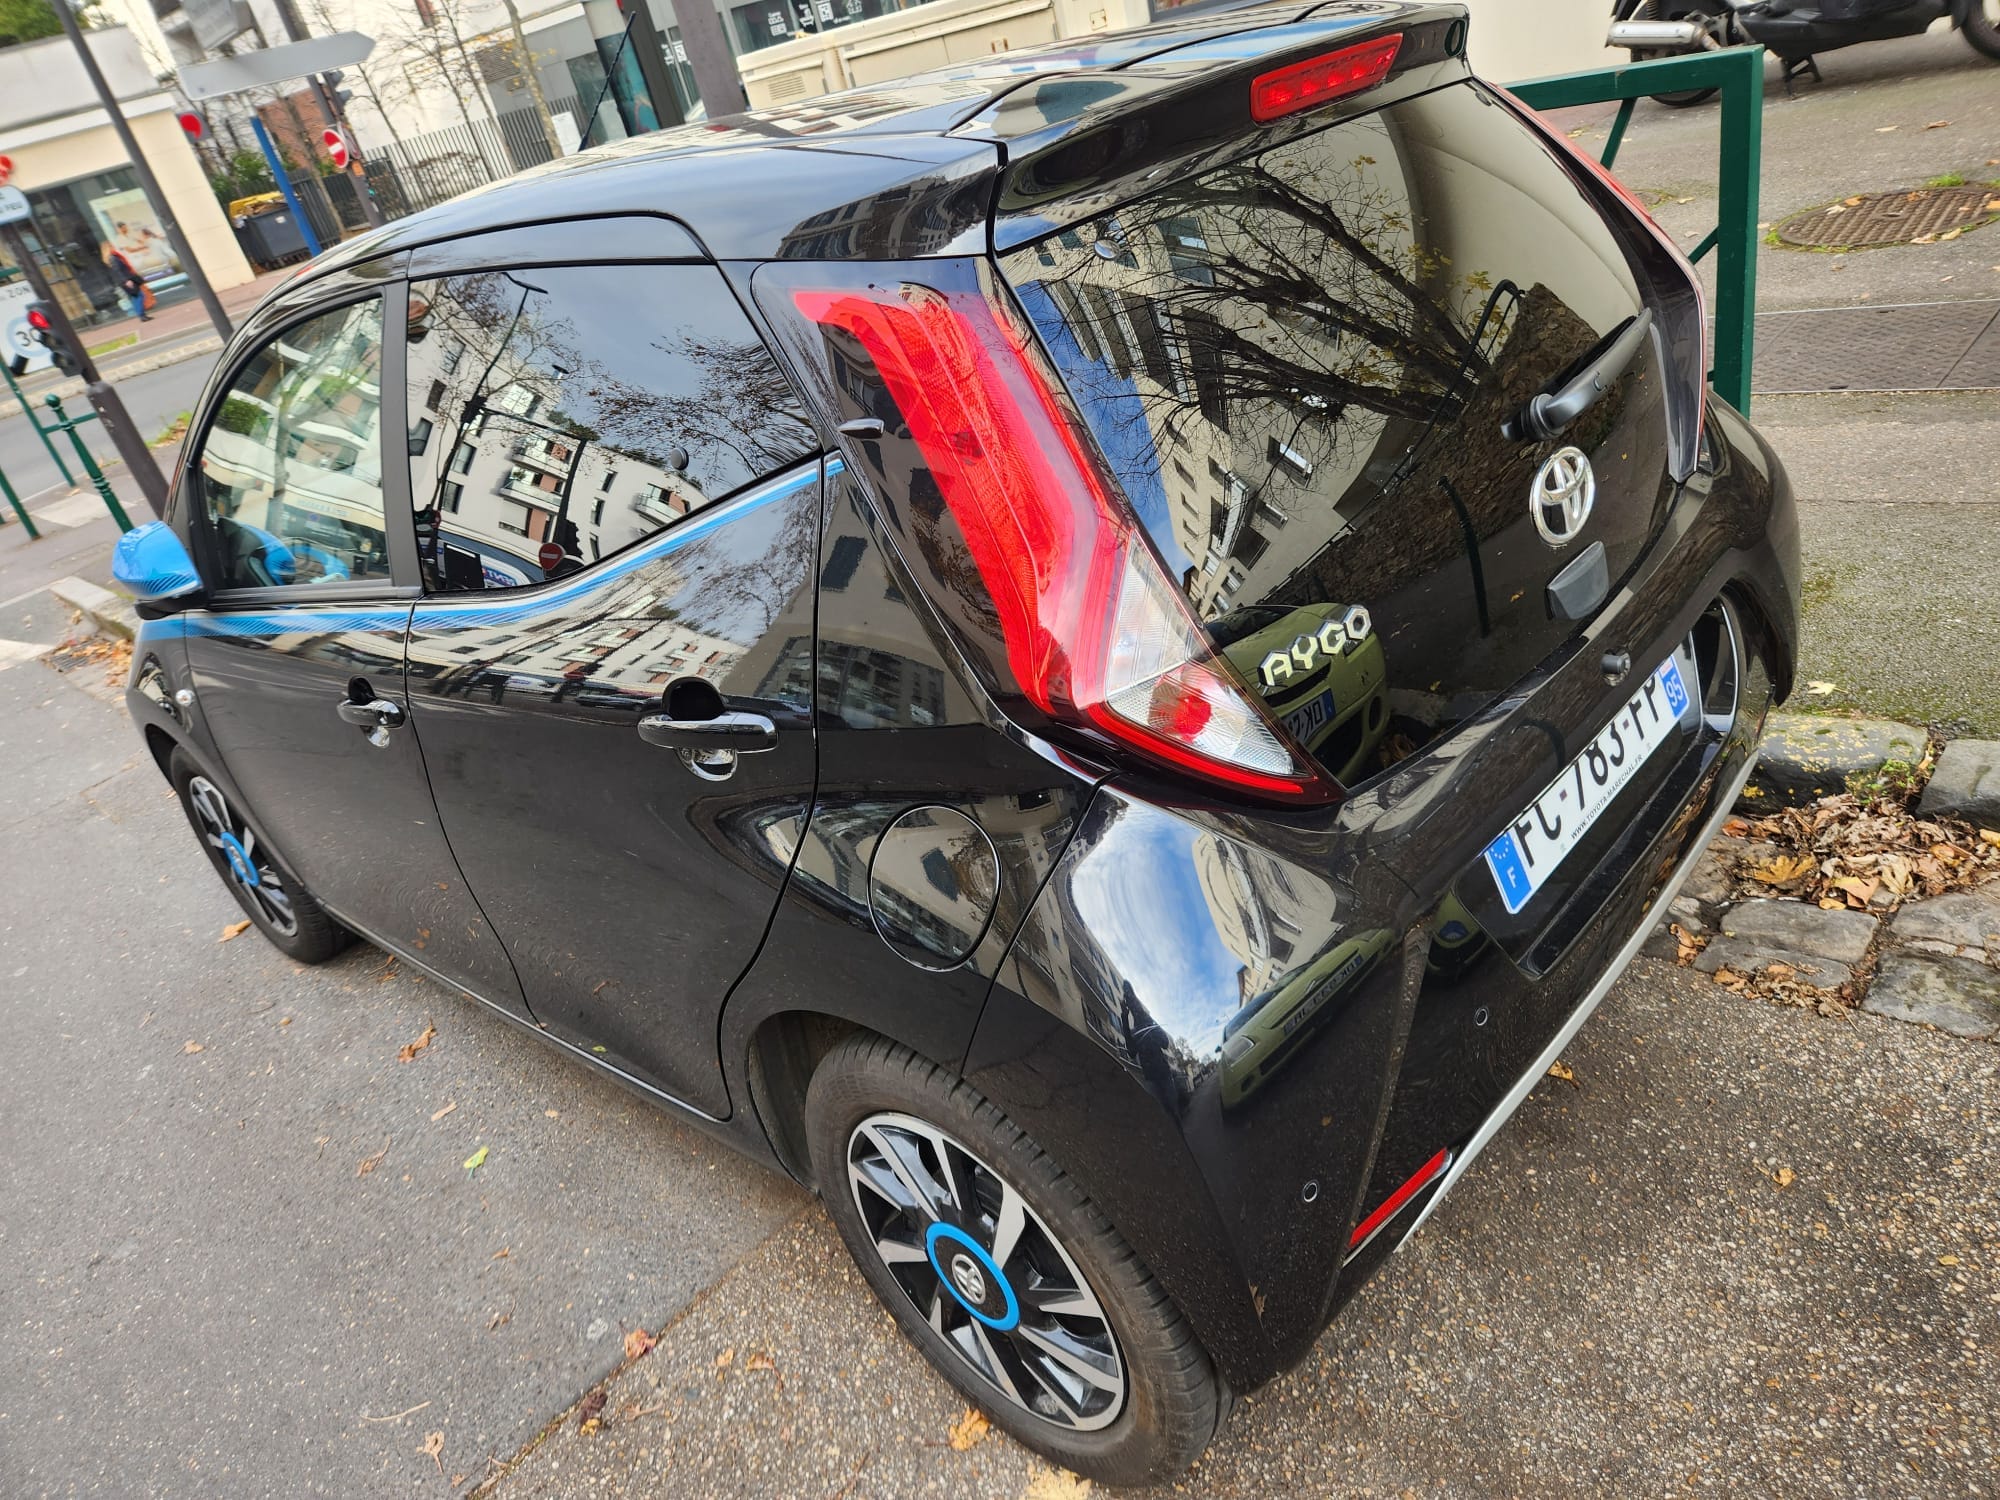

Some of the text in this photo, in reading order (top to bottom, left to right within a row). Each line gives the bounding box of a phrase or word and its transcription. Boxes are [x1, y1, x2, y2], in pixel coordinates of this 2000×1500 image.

[1257, 604, 1372, 687] AYGO
[1665, 673, 1684, 708] 95
[1506, 866, 1518, 889] F
